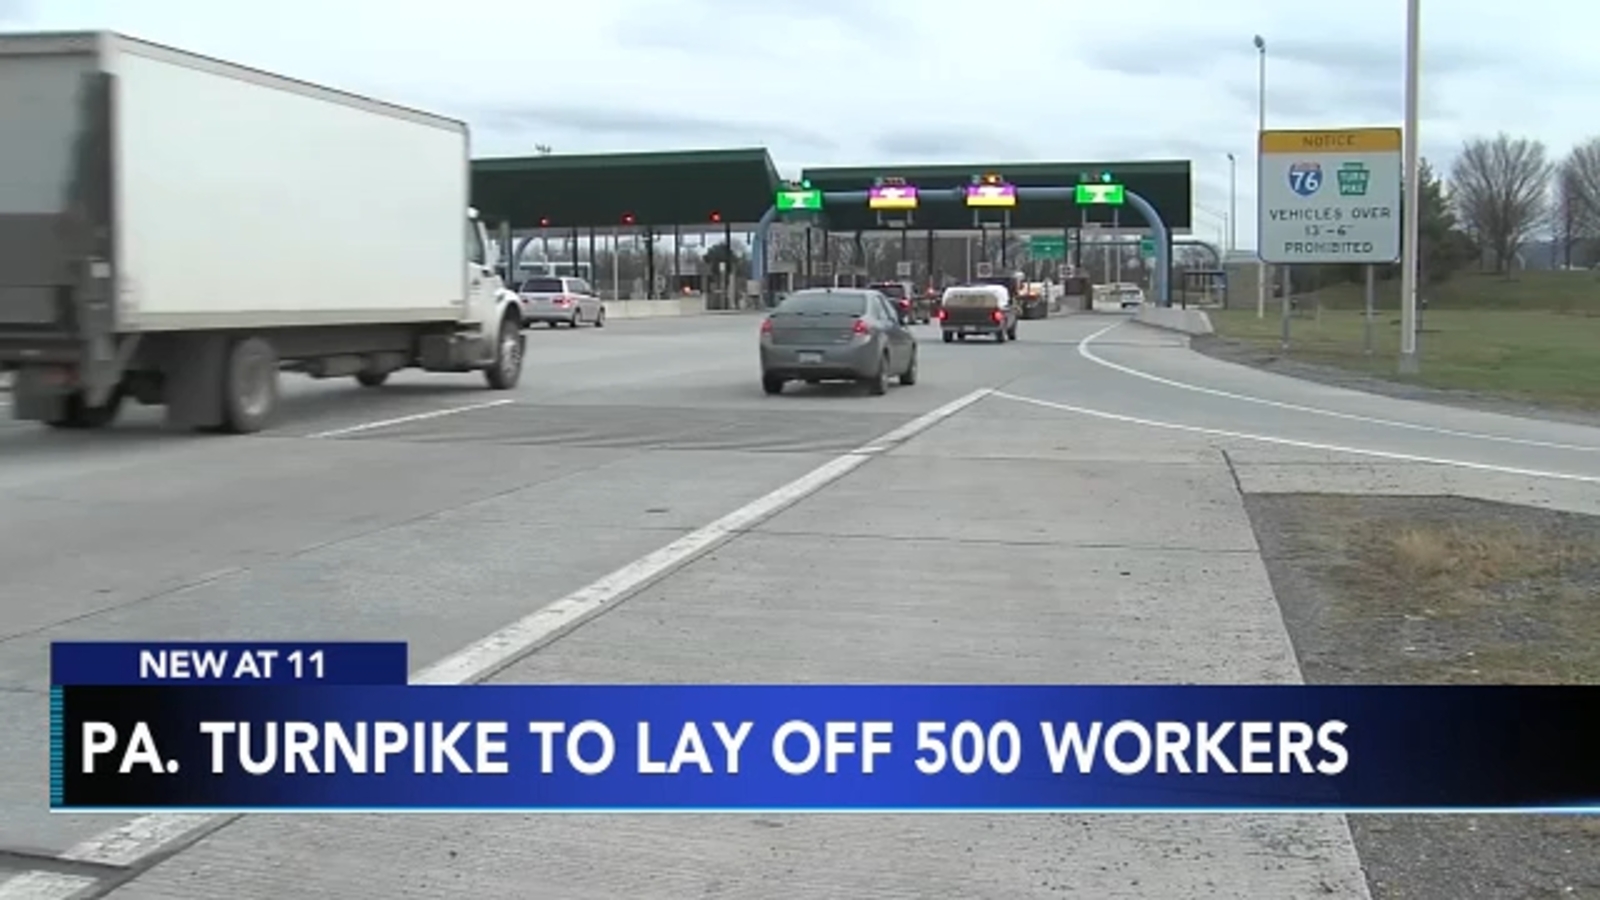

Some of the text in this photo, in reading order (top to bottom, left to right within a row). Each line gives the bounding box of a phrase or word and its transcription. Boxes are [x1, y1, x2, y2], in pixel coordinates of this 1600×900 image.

[1302, 134, 1355, 147] NOTICE
[1291, 171, 1319, 191] 76
[1269, 207, 1391, 220] VEHICLES OVER
[1284, 242, 1374, 253] PROHIBITED
